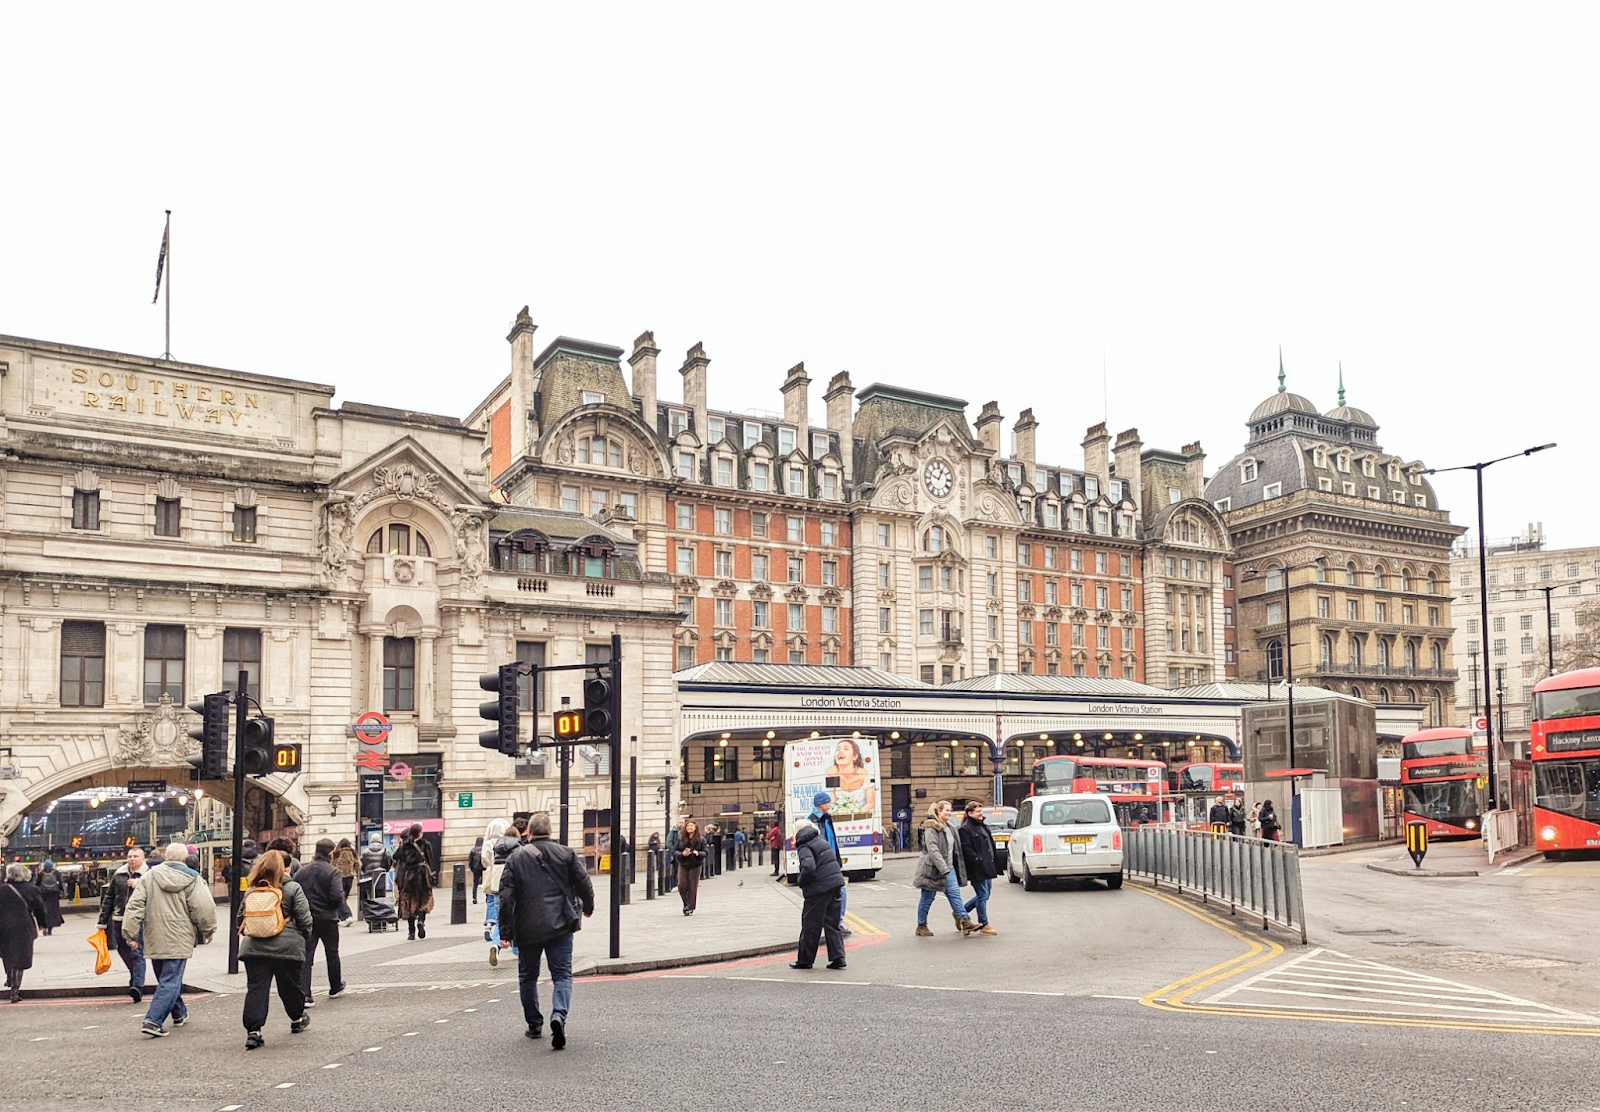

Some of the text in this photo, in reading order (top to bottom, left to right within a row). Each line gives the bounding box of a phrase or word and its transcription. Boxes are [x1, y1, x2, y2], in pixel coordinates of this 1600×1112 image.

[71, 368, 259, 408] SOUTHERN
[82, 390, 242, 426] RAILWAY
[801, 696, 901, 708] London Victoria Station
[1088, 704, 1163, 714] London Victoria Station
[559, 715, 579, 733] 01
[1552, 736, 1581, 746] Hackney
[278, 749, 295, 766] 01
